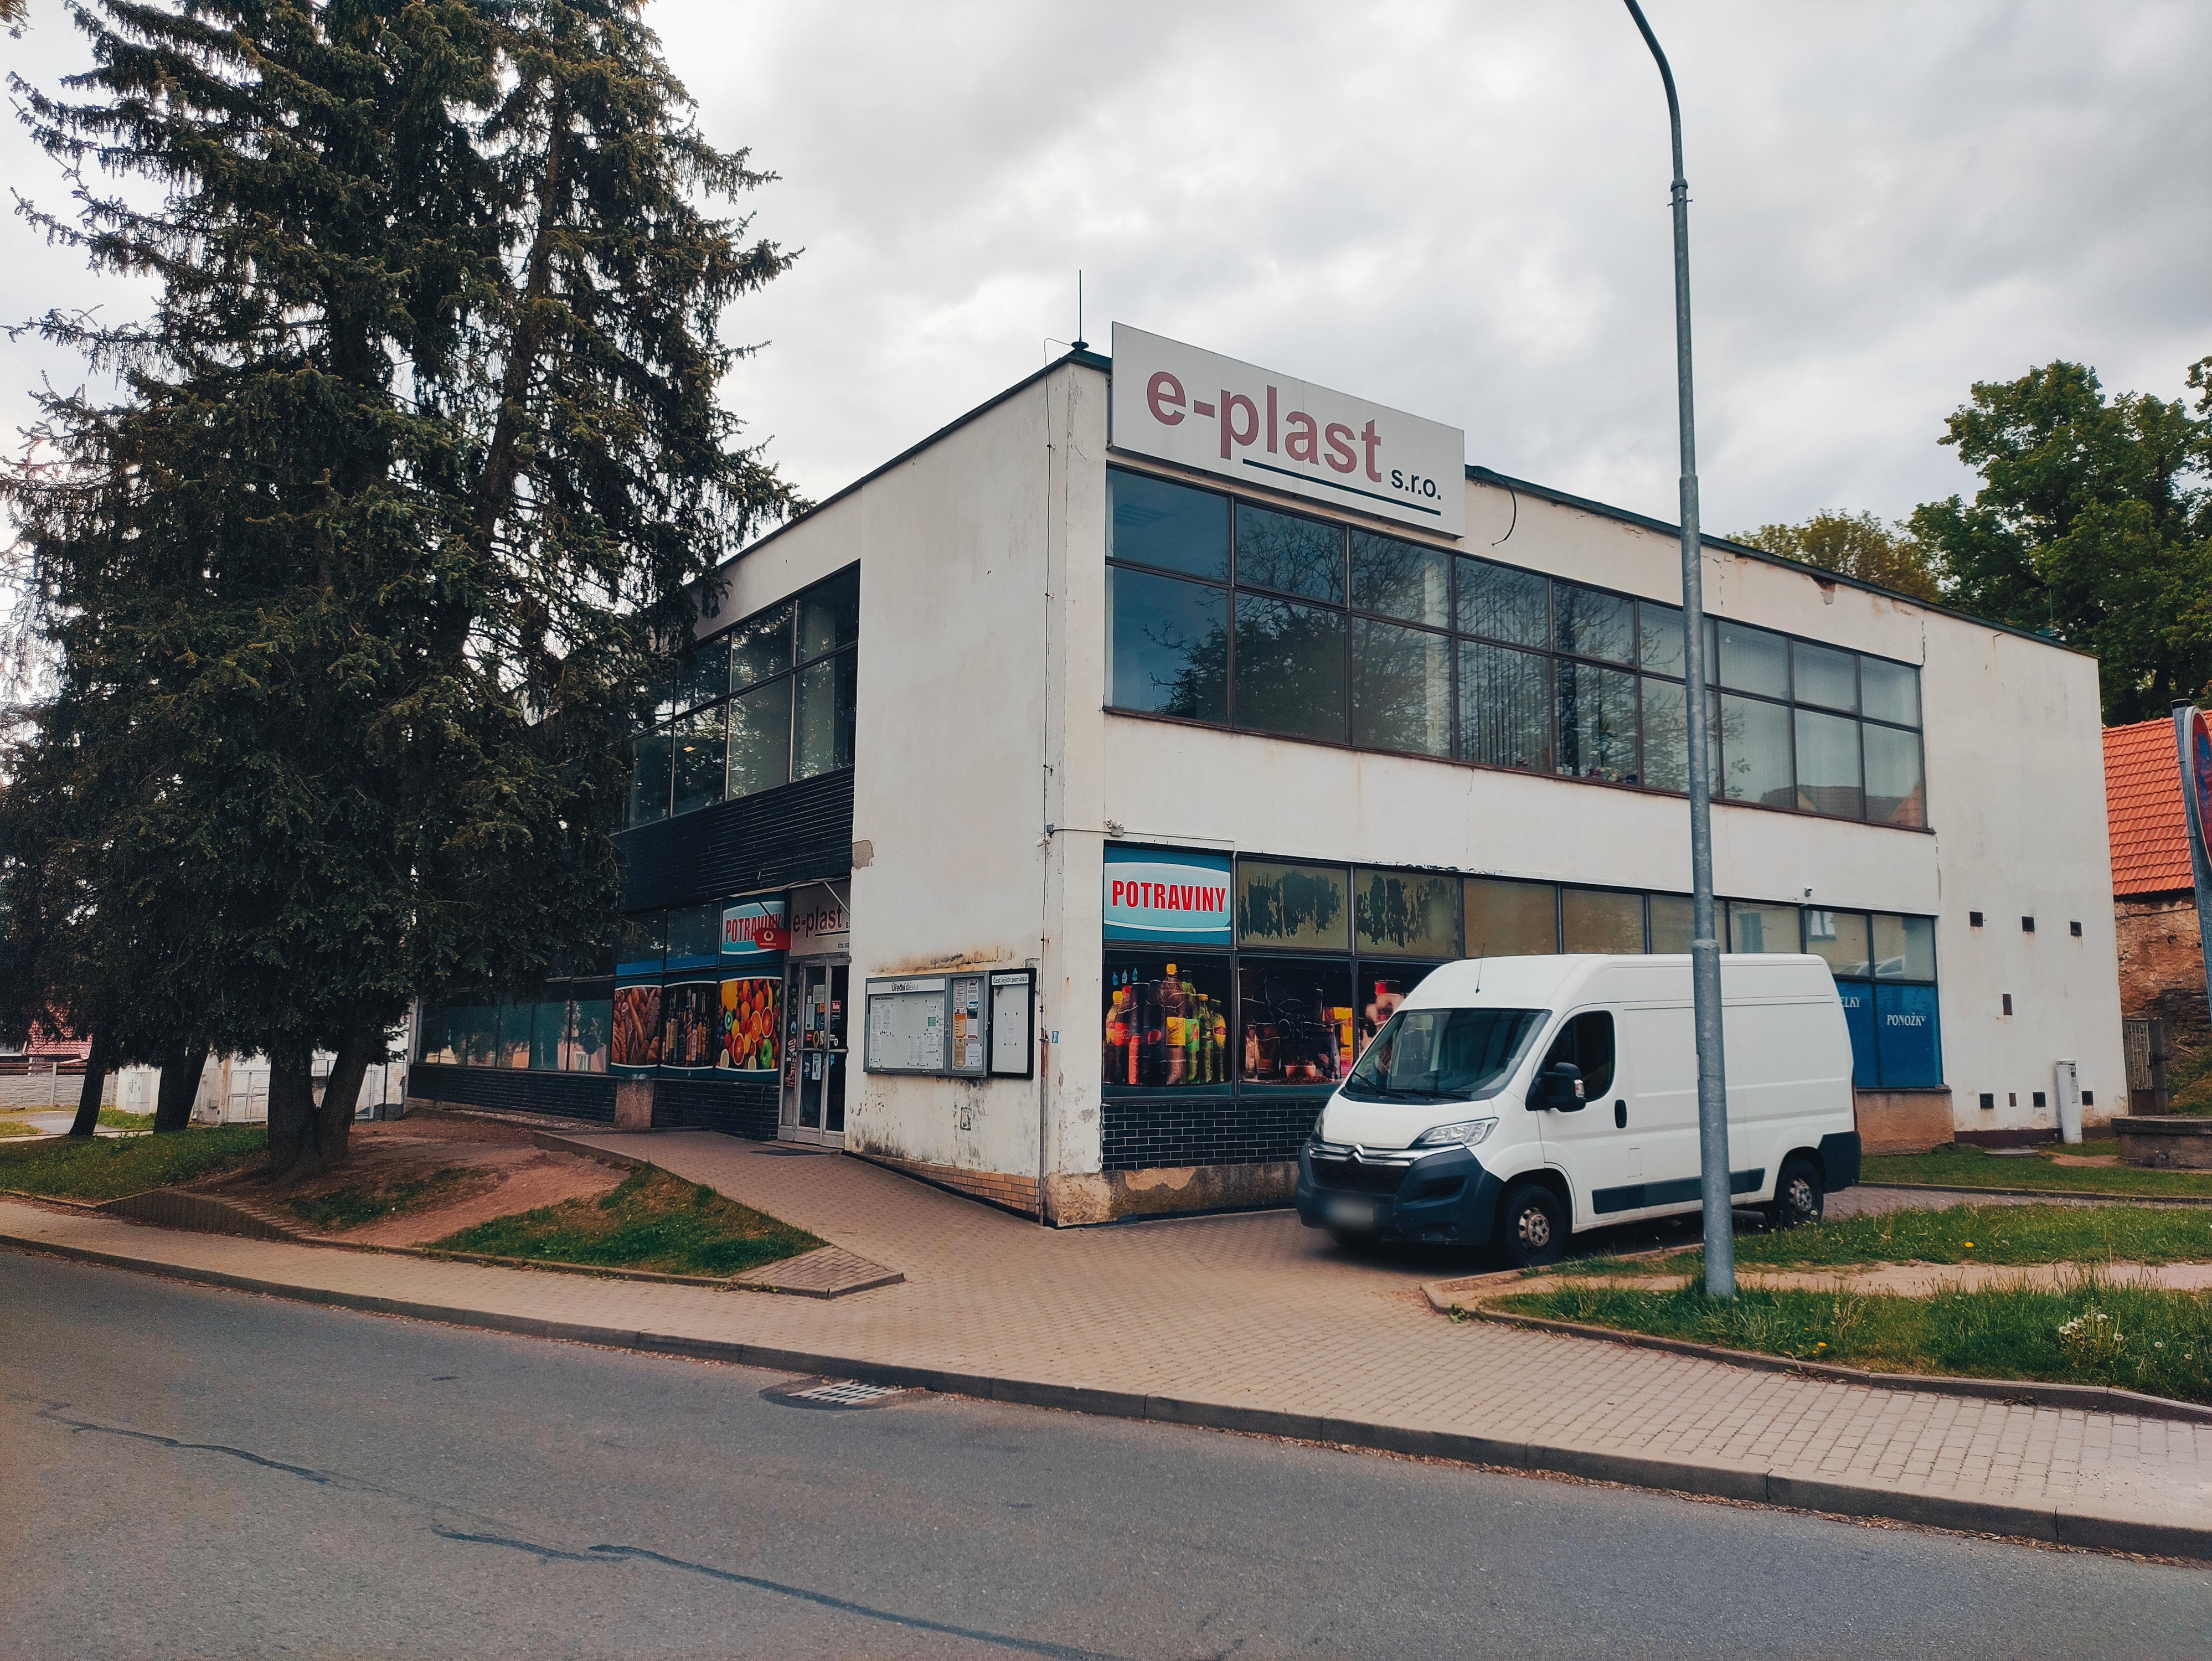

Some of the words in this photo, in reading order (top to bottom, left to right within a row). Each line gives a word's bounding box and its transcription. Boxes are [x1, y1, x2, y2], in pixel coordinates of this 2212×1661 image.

[1147, 371, 1382, 483] e-plast
[1391, 469, 1442, 501] s.r.o.
[1112, 880, 1226, 912] POTRAVINY
[793, 903, 842, 938] e-plast
[891, 982, 906, 992] Úřední
